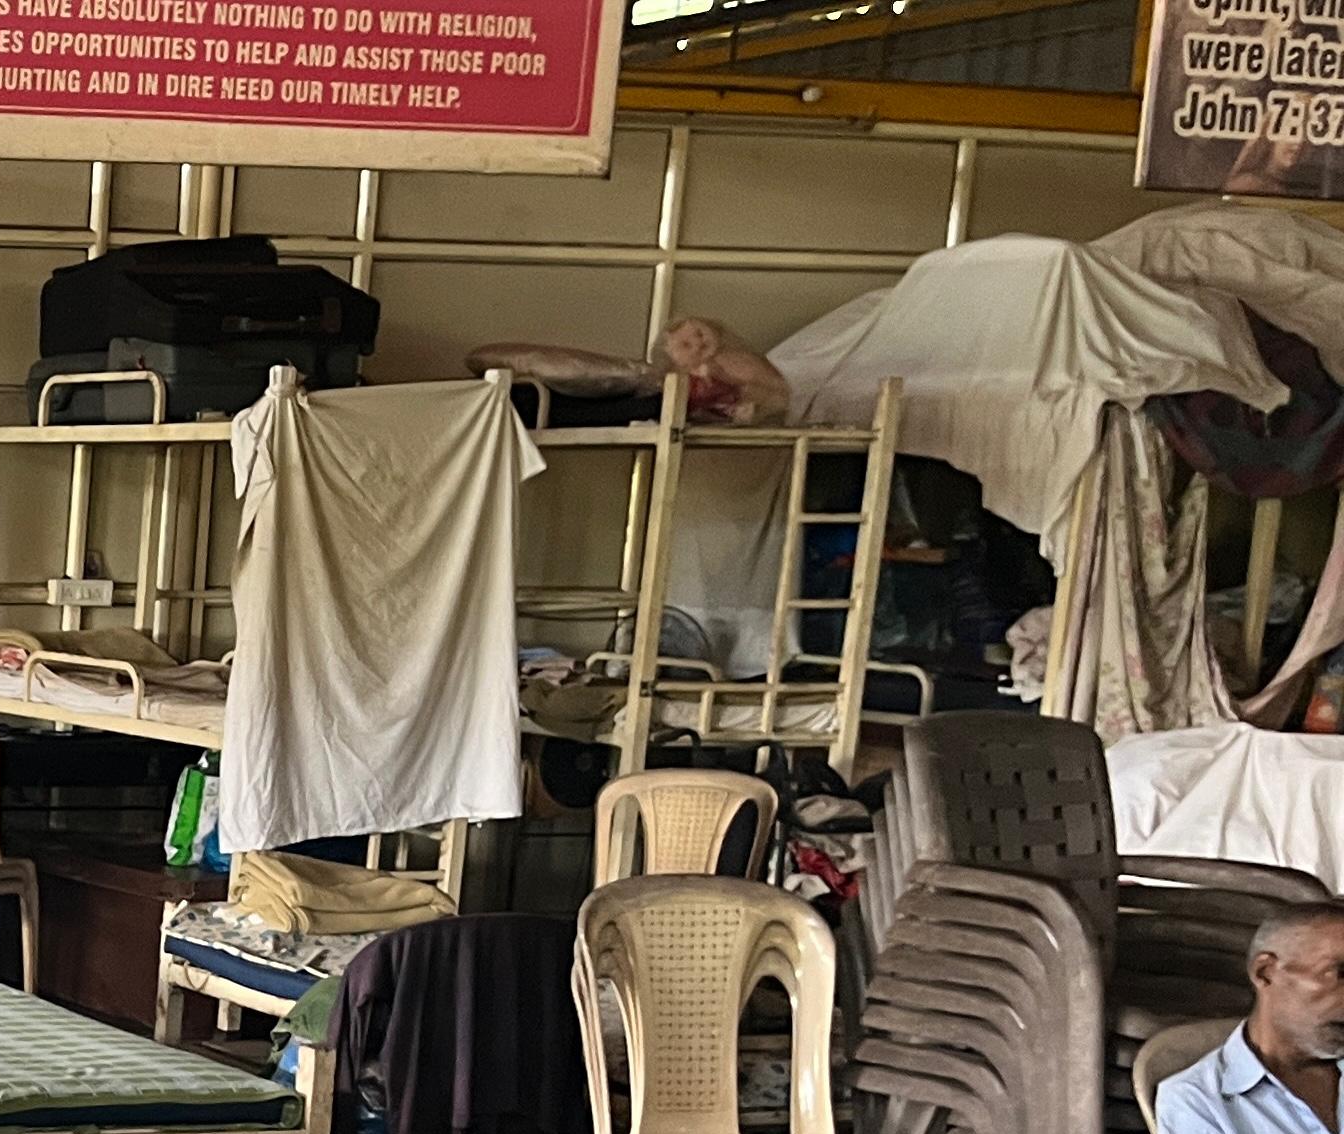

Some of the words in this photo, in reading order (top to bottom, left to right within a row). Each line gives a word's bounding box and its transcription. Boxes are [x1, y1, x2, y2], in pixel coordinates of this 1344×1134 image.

[18, 0, 72, 18] HAVE
[79, 0, 207, 23] ABSOLUTELY
[214, 1, 305, 29] NOTHING
[311, 7, 338, 30] TO
[344, 10, 373, 33] DO
[380, 11, 432, 36] WITH
[438, 13, 537, 43] RELIGION,
[31, 31, 197, 61] OPPORTUNITIES
[203, 39, 229, 63] TO
[236, 41, 289, 66] HELP
[294, 44, 336, 68] AND
[342, 46, 413, 71] ASSIST
[420, 49, 484, 74] THOSE
[490, 51, 547, 76] POOR
[1187, 38, 1265, 74] were
[88, 71, 130, 94] AND
[138, 73, 159, 96] IN
[166, 74, 213, 98] DIRE
[221, 77, 274, 101] NEED
[281, 79, 323, 103] OUR
[330, 81, 403, 107] TIMELY
[408, 84, 462, 108] HELP.
[1179, 91, 1257, 133] John
[1271, 97, 1300, 137] 7:
